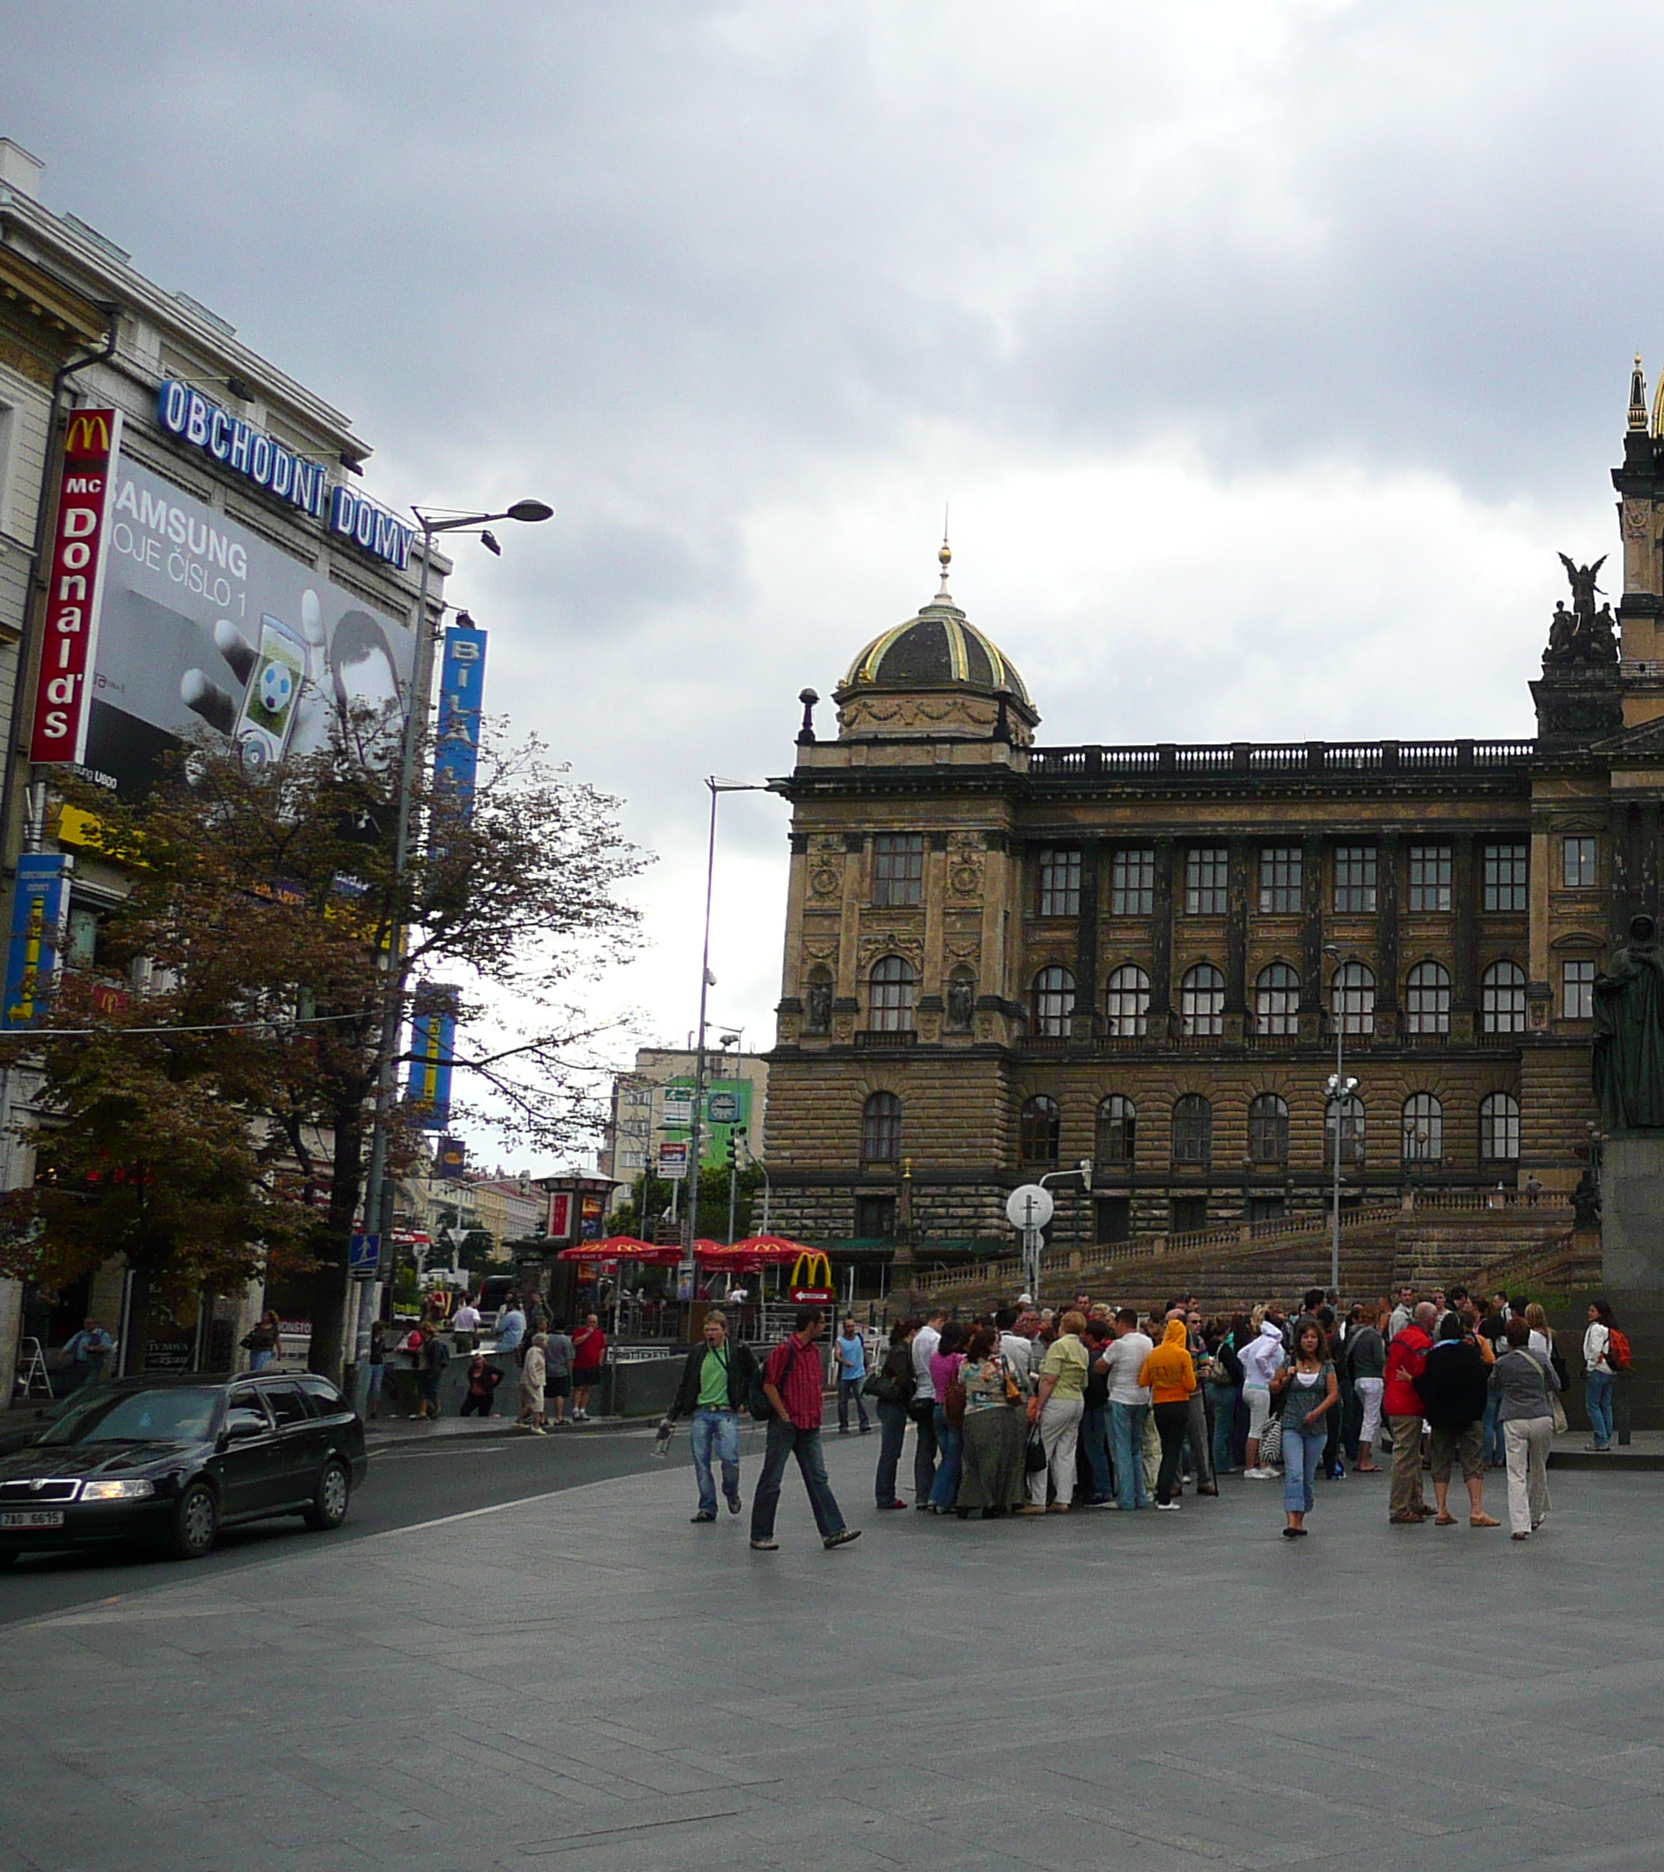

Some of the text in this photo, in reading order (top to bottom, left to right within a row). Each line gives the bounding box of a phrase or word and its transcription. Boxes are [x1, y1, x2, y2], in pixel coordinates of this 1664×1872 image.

[160, 380, 415, 571] OBCHODNÍ DOMY
[109, 520, 246, 617] OJE ČÍSLO 1
[113, 478, 248, 581] AMSUNG
